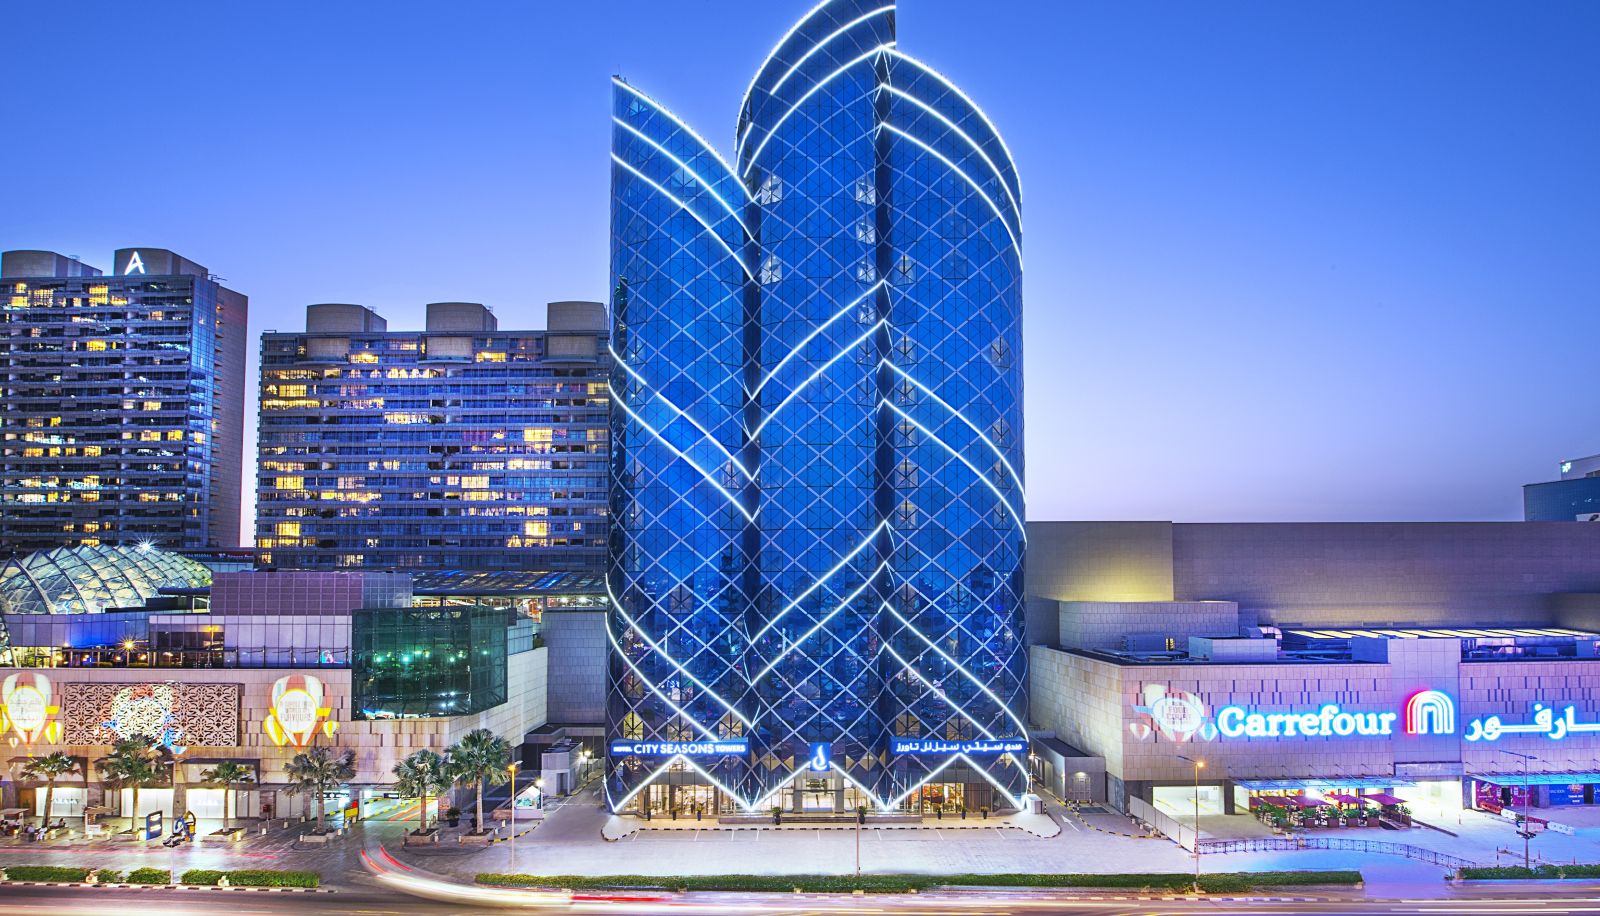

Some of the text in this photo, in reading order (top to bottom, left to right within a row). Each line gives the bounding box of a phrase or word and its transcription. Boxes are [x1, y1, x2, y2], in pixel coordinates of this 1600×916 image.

[1217, 705, 1397, 737] Carrefour
[1464, 703, 1600, 741] ارفور
[633, 744, 659, 754] CITY
[660, 743, 714, 754] SEASONS
[715, 744, 746, 752] TOWERS
